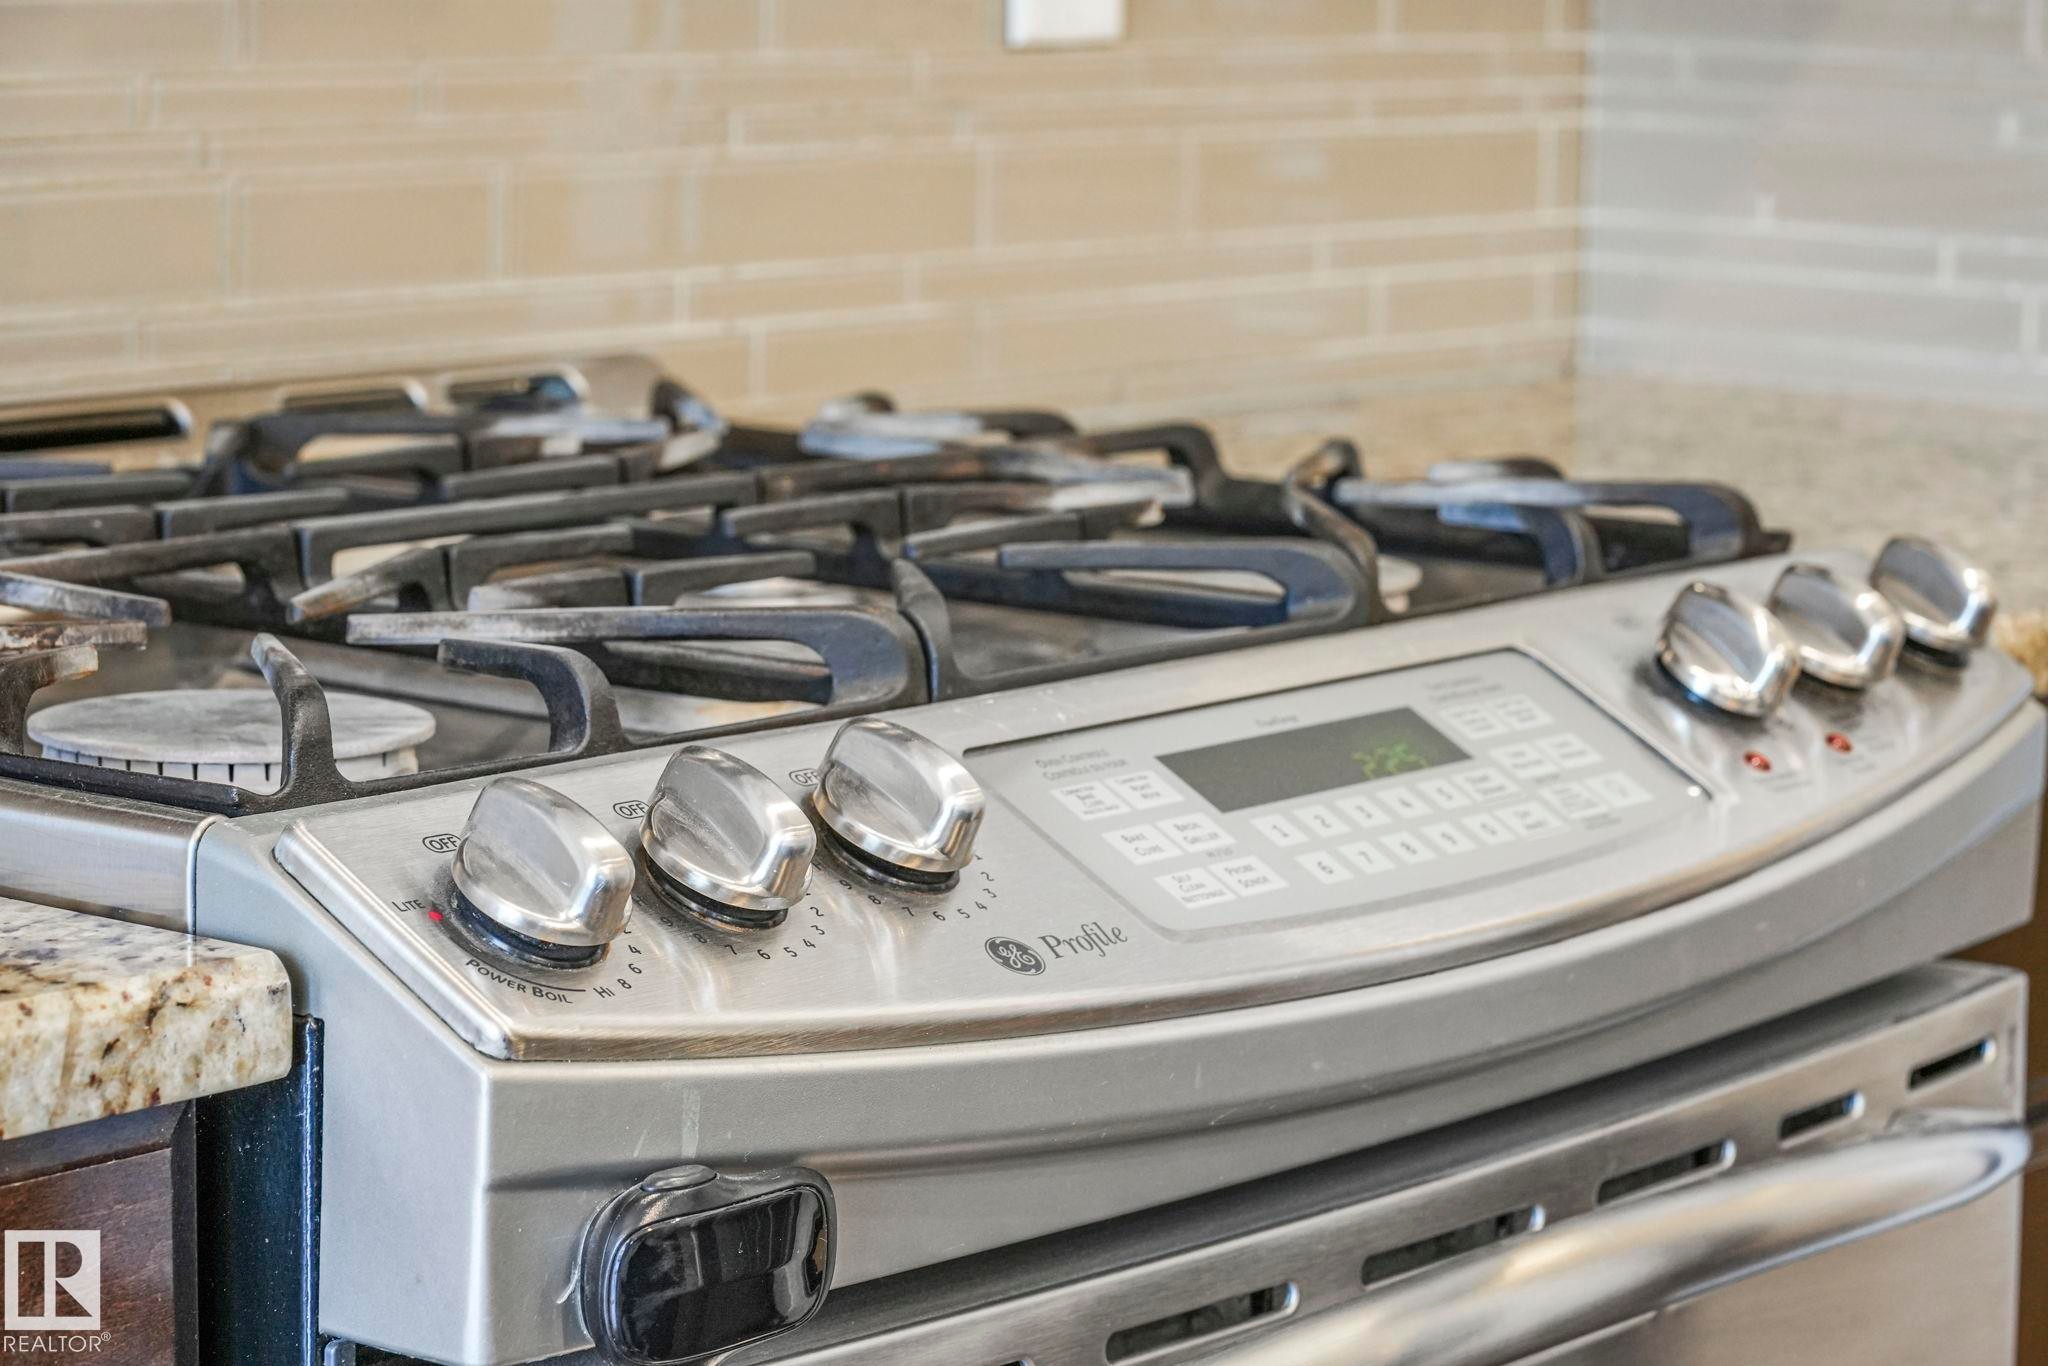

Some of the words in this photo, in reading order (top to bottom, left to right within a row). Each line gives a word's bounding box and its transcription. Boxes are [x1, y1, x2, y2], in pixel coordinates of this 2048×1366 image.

[618, 802, 648, 817] OFF
[428, 837, 460, 851] OFF
[980, 871, 995, 882] 2
[982, 888, 997, 898] 3
[868, 895, 881, 905] 8
[975, 901, 987, 910] 4
[391, 899, 426, 913] LITE
[809, 906, 824, 917] 2
[902, 906, 915, 917] 7
[932, 911, 946, 921] 6
[957, 908, 970, 919] 5
[810, 924, 825, 935] 3
[803, 938, 816, 949] 4
[1038, 921, 1128, 959] Profile
[627, 944, 642, 955] 4
[724, 944, 737, 956] 7
[757, 949, 771, 960] 6
[783, 946, 798, 957] 5
[628, 962, 643, 975] 6
[465, 959, 527, 993] POWER
[532, 986, 574, 1004] BOIL
[617, 978, 632, 990] 8
